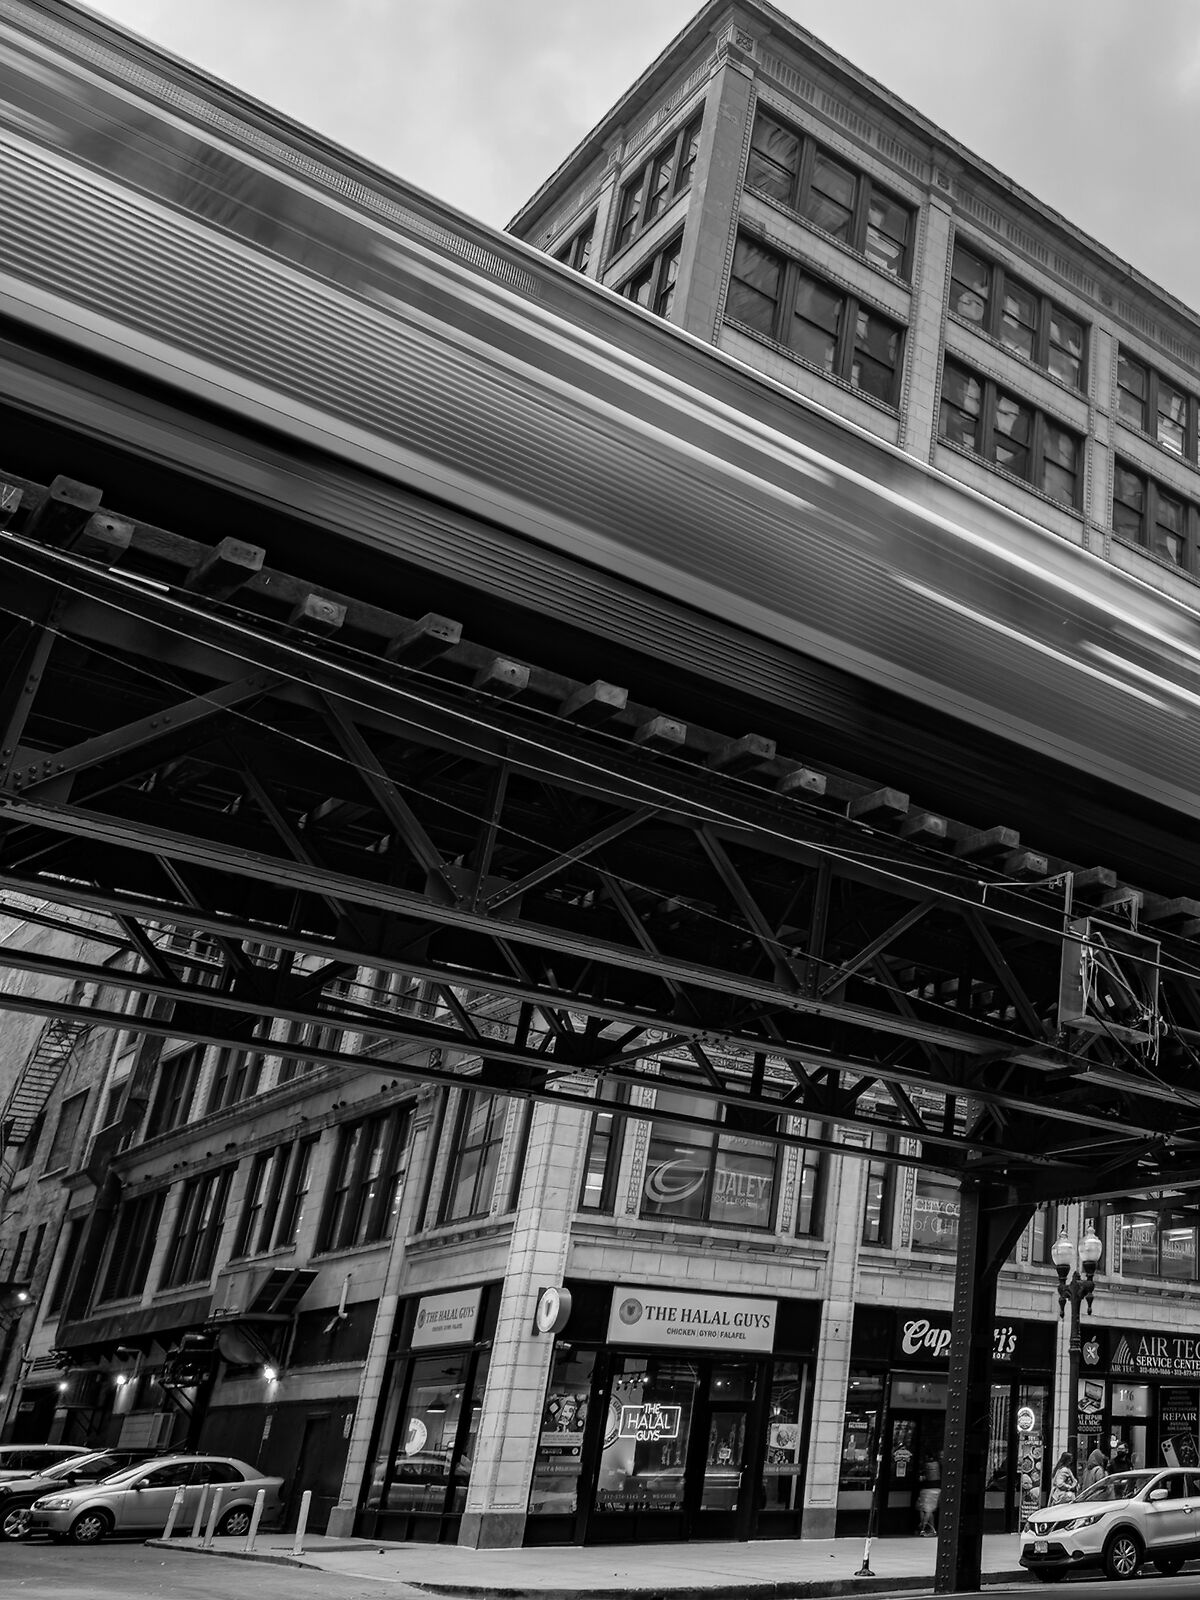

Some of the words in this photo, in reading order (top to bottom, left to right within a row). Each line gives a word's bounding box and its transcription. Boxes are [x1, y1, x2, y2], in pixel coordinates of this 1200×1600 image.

[715, 1173, 767, 1199] DALEY
[915, 1198, 943, 1212] CITY
[645, 1305, 677, 1322] THE
[680, 1308, 730, 1326] HALAL
[734, 1312, 771, 1329] GUYS
[666, 1327, 696, 1337] CHICKEN
[699, 1329, 717, 1338] GYRO
[720, 1330, 747, 1340] FALAFEL
[1137, 1336, 1168, 1357] AIR
[1135, 1355, 1172, 1369] SERVICE
[1111, 1365, 1121, 1373] AIR
[1121, 1365, 1135, 1374] TEC
[644, 1403, 661, 1414] THE
[627, 1413, 671, 1430] HALAL
[1162, 1412, 1197, 1421] REPAIR
[636, 1430, 661, 1441] GUYS
